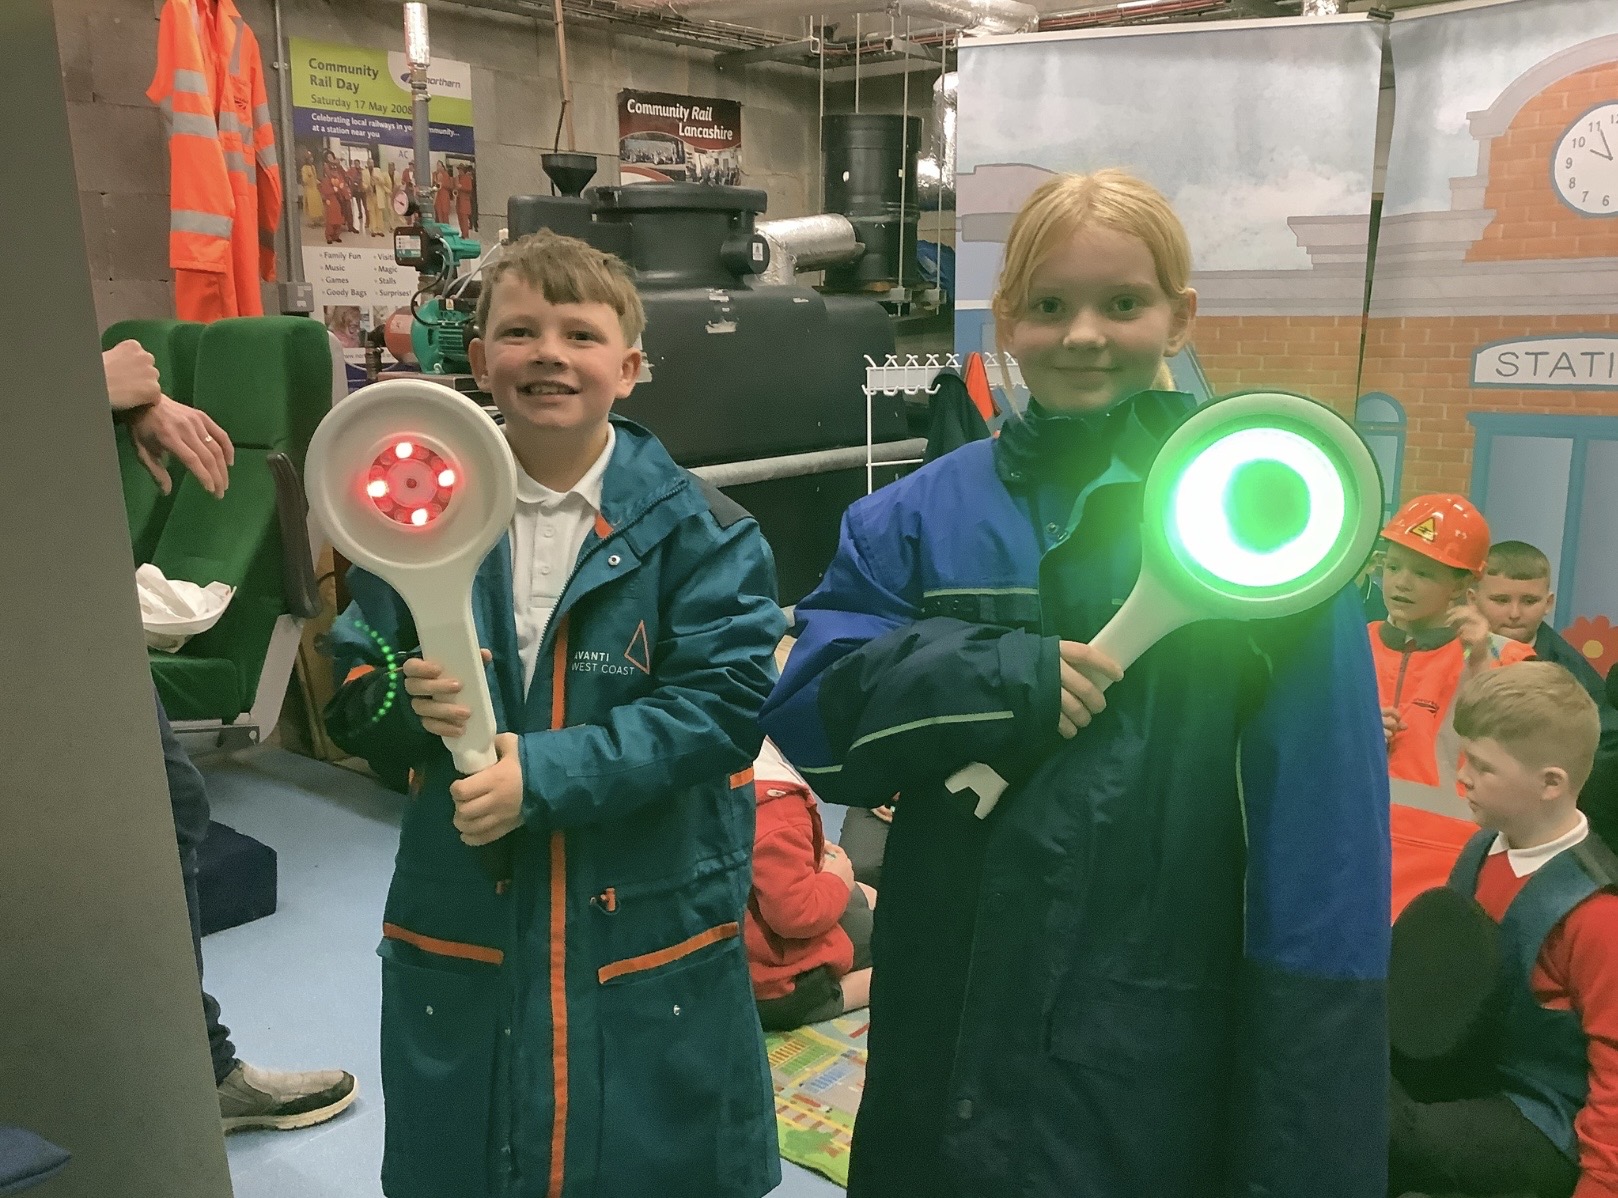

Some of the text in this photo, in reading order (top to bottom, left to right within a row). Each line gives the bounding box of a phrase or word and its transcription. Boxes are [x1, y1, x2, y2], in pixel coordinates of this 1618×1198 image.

[308, 57, 379, 80] Community
[310, 75, 360, 94] Rail Day
[310, 94, 413, 115] Saturday 17 May 2008
[626, 98, 713, 122] Community Rail
[311, 112, 351, 126] Celebrating
[351, 117, 367, 127] local
[368, 119, 396, 131] railways
[396, 122, 403, 130] in
[1588, 120, 1601, 133] 11
[326, 126, 350, 135] station
[351, 128, 366, 137] near
[367, 130, 381, 139] you
[678, 122, 733, 140] Lancashire
[1572, 136, 1586, 149] 10
[1565, 157, 1573, 169] 9
[1568, 176, 1576, 189] 8
[1582, 190, 1589, 203] 7
[1602, 194, 1610, 207] 6
[323, 251, 346, 260] Family
[324, 264, 345, 272] Music
[378, 265, 398, 274] Magic
[325, 276, 349, 284] Games
[378, 277, 397, 285] Stalls
[326, 288, 367, 298] Goody Bags
[379, 289, 411, 298] Surprises!
[1495, 351, 1614, 378] STATI
[571, 662, 635, 676] WEST COAST
